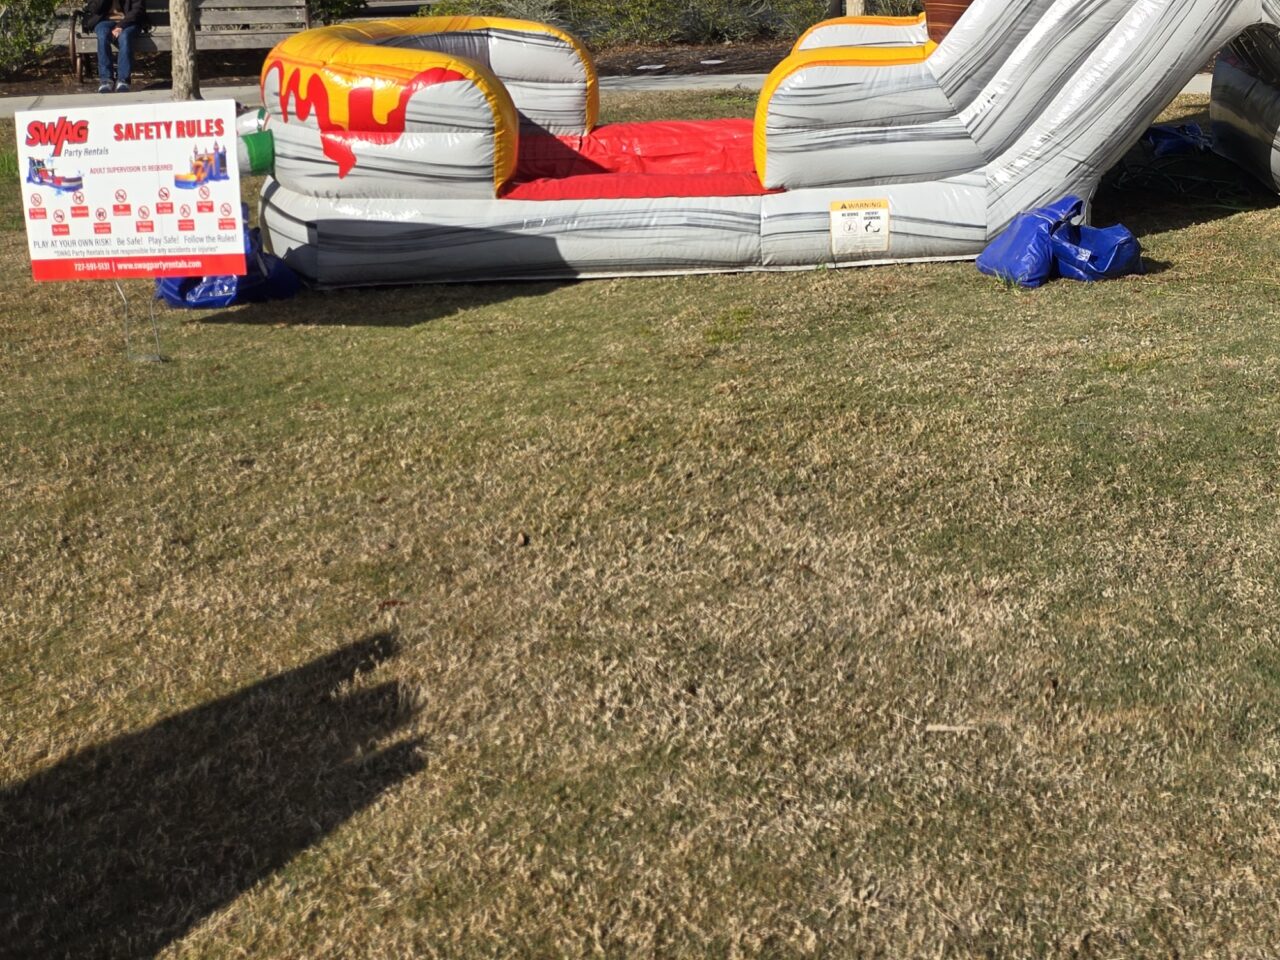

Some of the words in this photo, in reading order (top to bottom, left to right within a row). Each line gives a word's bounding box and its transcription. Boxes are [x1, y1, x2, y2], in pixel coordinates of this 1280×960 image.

[25, 116, 89, 157] SWAG
[113, 121, 172, 141] SAFETY
[176, 118, 225, 138] RULES
[64, 148, 82, 158] Party
[84, 147, 109, 156] Rentals
[90, 166, 105, 174] ADULT
[33, 240, 49, 249] PLAY
[51, 240, 58, 248] AT
[60, 239, 76, 248] YOUR
[78, 239, 94, 247] OWN
[117, 237, 125, 246] Be
[127, 237, 143, 245] Safe!
[148, 236, 162, 246] Play
[184, 235, 204, 243] Follow
[206, 234, 216, 243] the
[217, 234, 237, 242] Rules!
